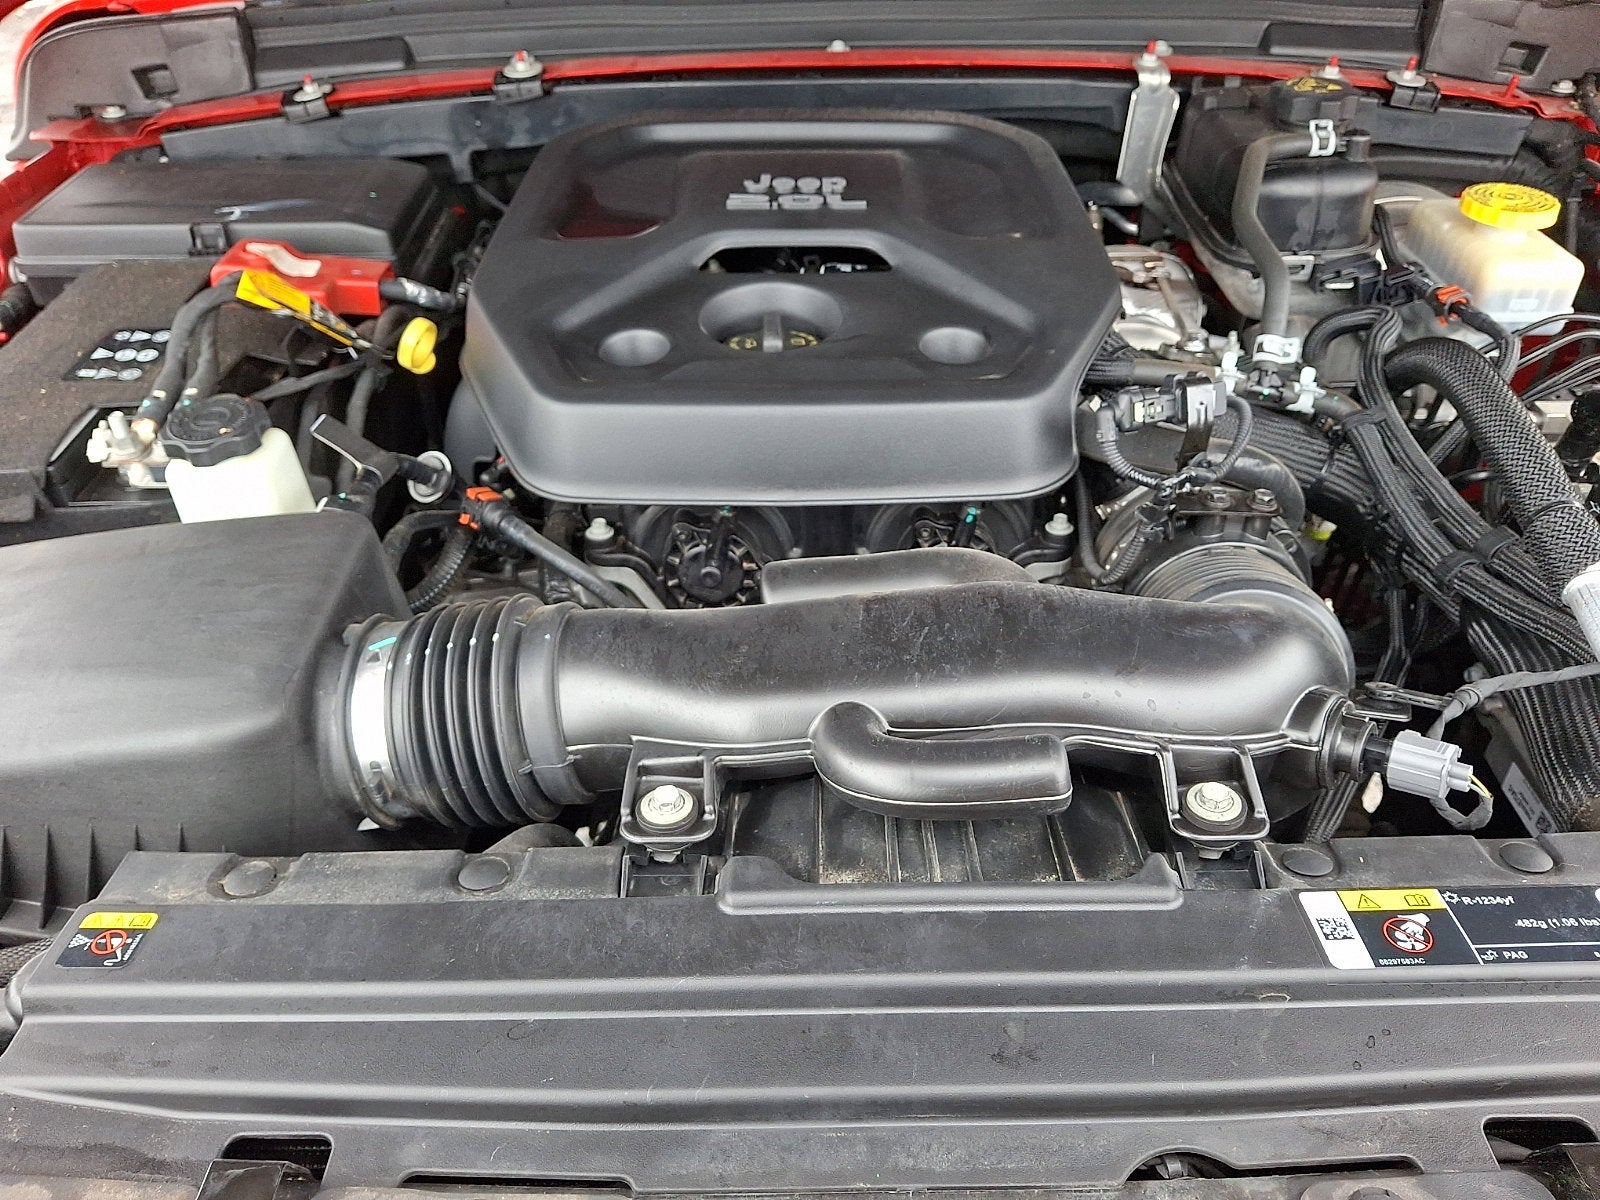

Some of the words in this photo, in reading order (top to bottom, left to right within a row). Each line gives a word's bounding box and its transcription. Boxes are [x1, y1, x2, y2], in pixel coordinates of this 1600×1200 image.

[743, 173, 847, 194] Jeep
[726, 193, 868, 210] 2.0L
[1502, 950, 1529, 960] PAG
